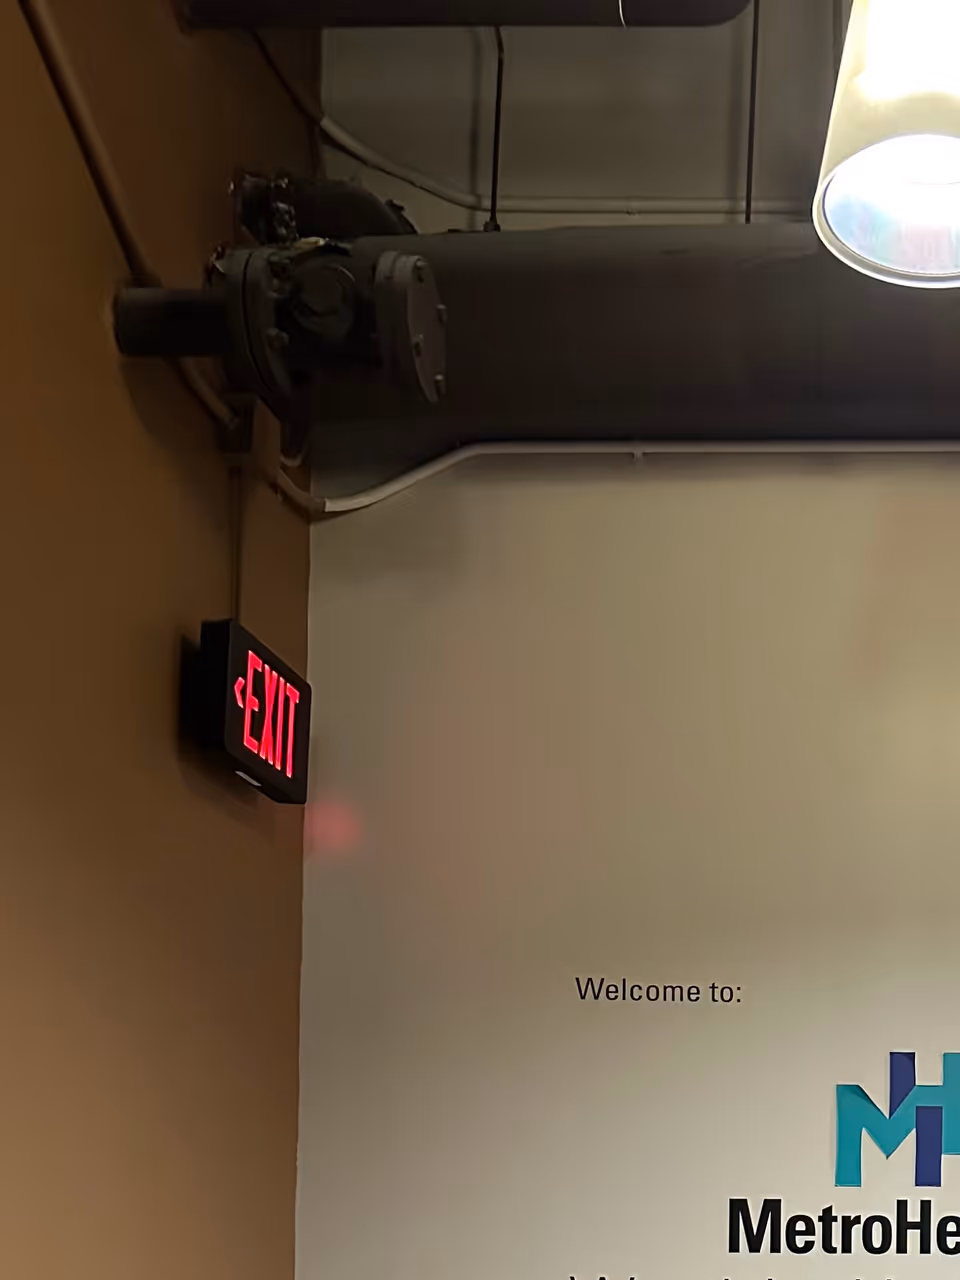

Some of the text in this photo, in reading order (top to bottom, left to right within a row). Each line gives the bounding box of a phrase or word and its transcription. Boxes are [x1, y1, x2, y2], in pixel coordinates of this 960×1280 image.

[243, 649, 300, 778] EXIT
[575, 977, 742, 1003] Welcome to:
